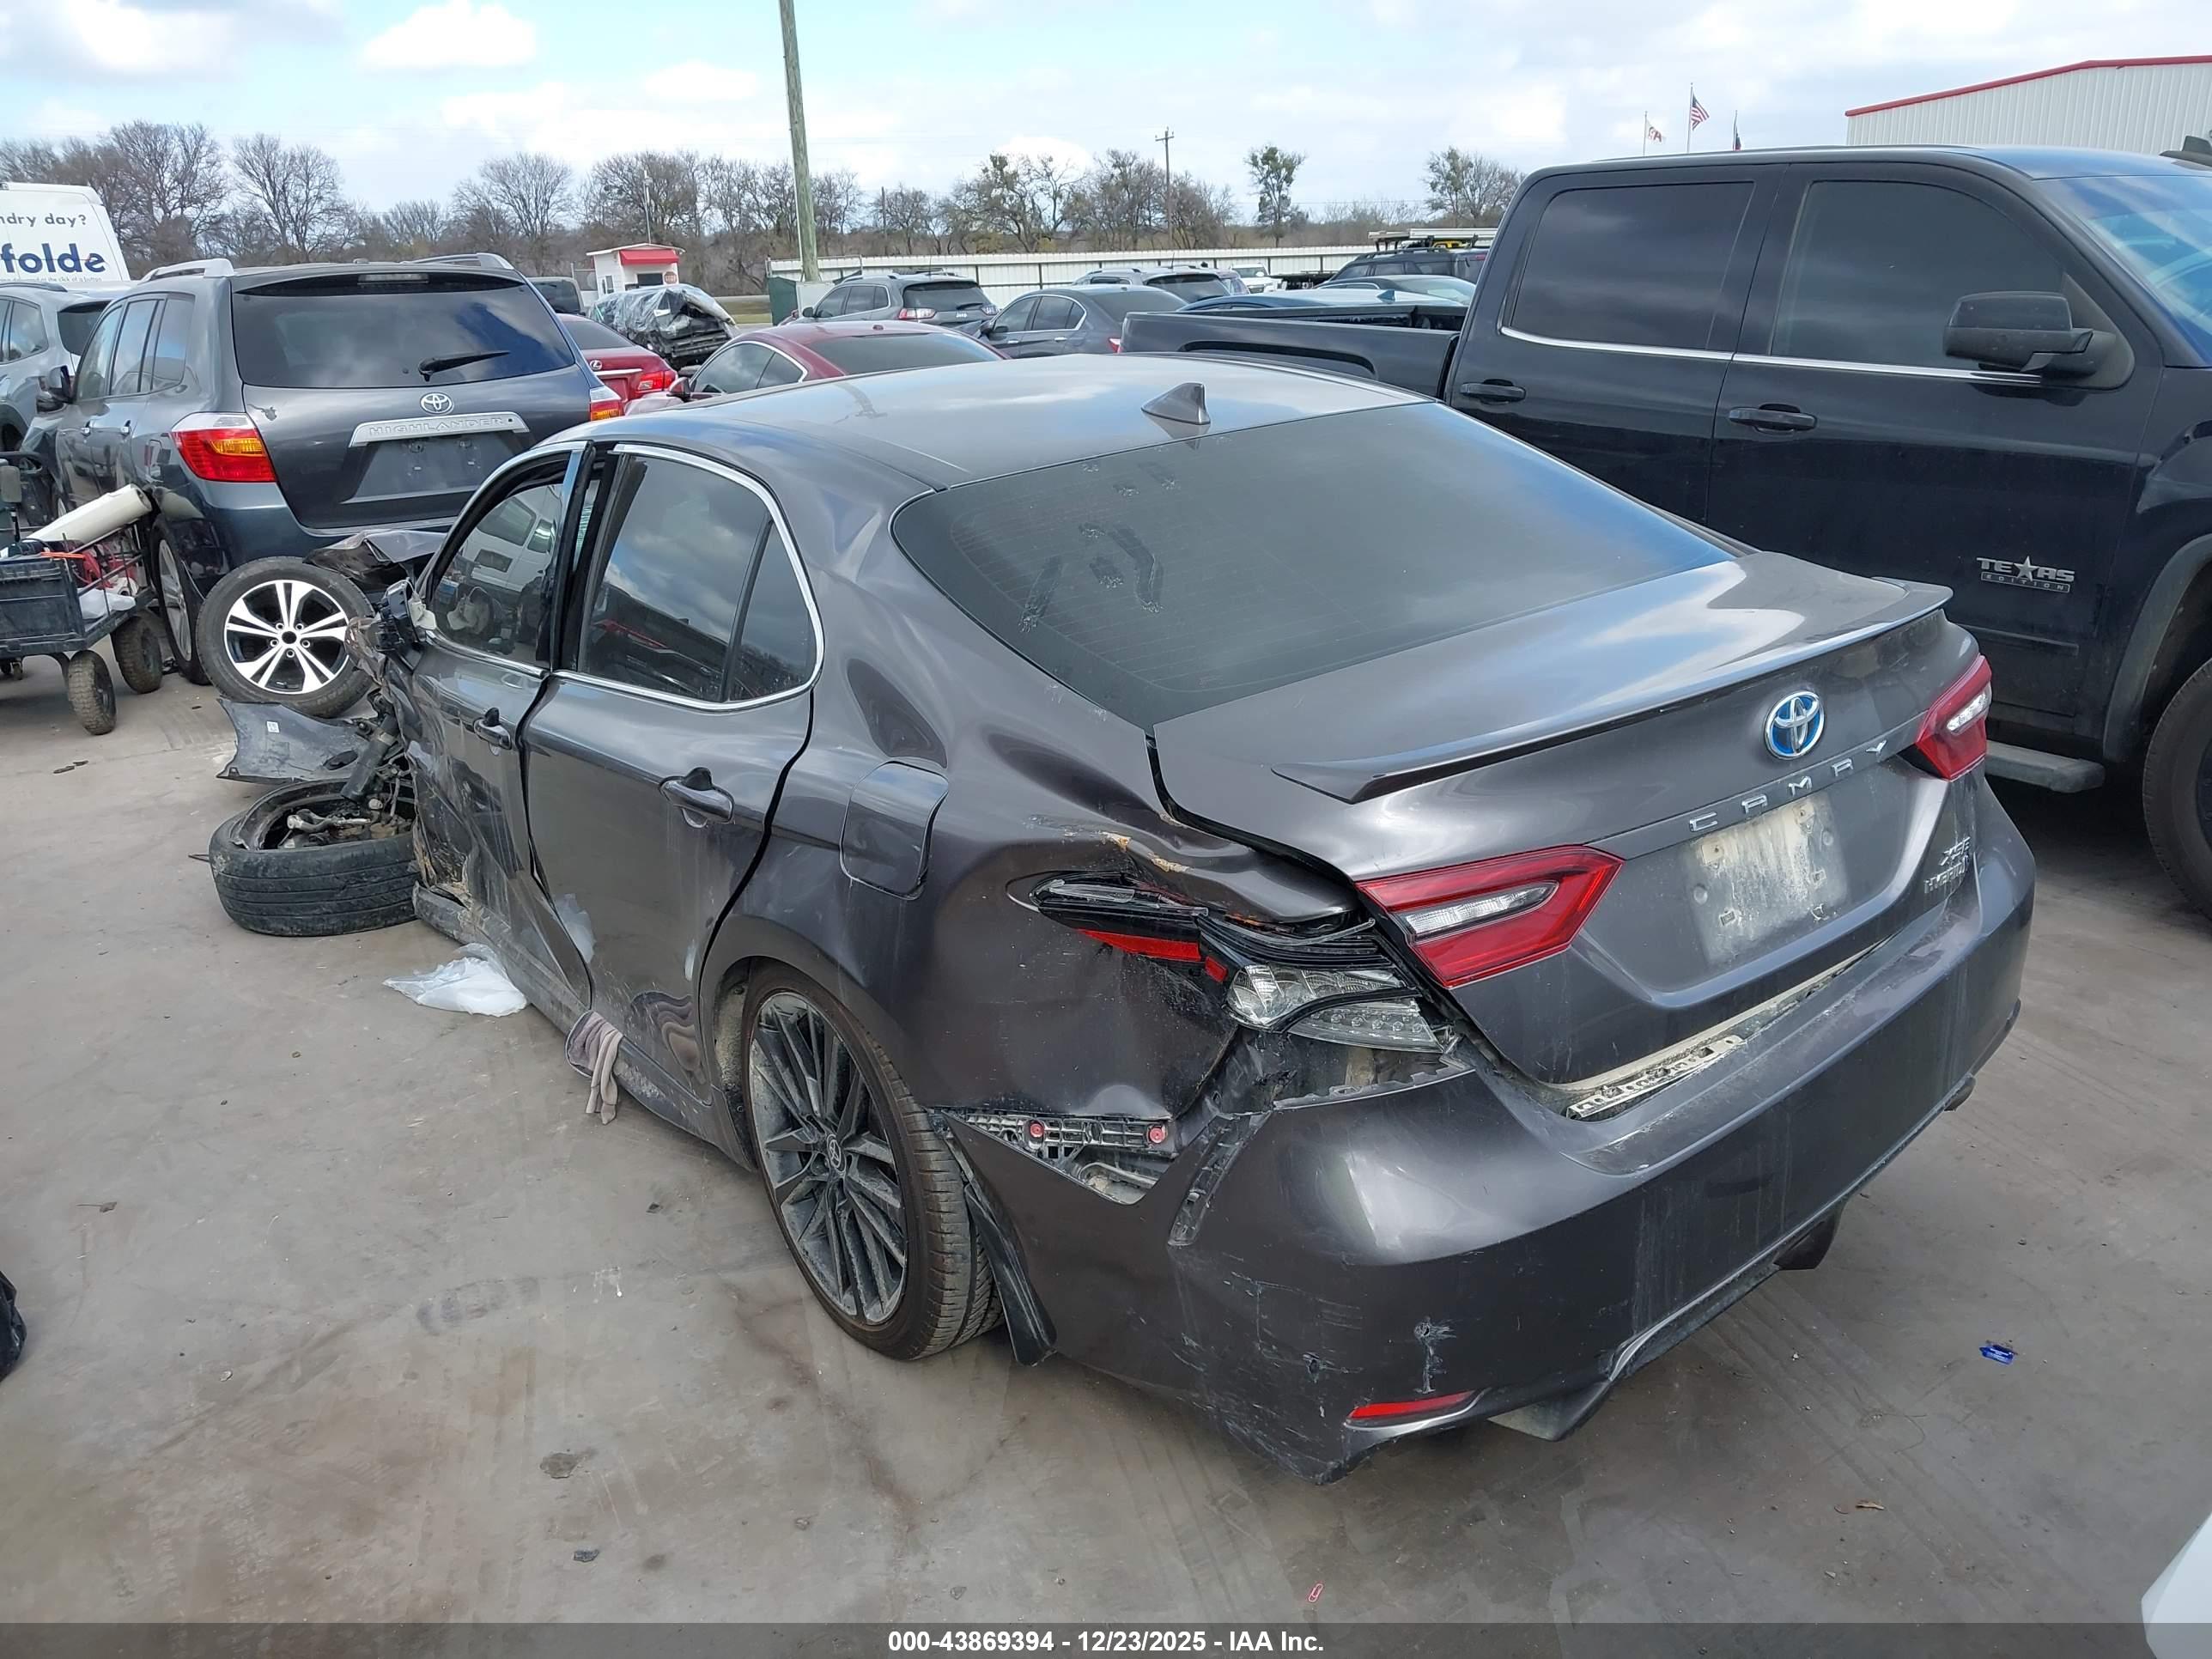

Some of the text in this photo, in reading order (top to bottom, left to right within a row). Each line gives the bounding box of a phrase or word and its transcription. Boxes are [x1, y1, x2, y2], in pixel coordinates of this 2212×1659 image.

[45, 213, 87, 228] day?
[0, 243, 106, 273] folde
[369, 418, 504, 435] HIGHLANDER
[1985, 574, 2064, 591] EDITION
[1689, 739, 1887, 832] CAMRY
